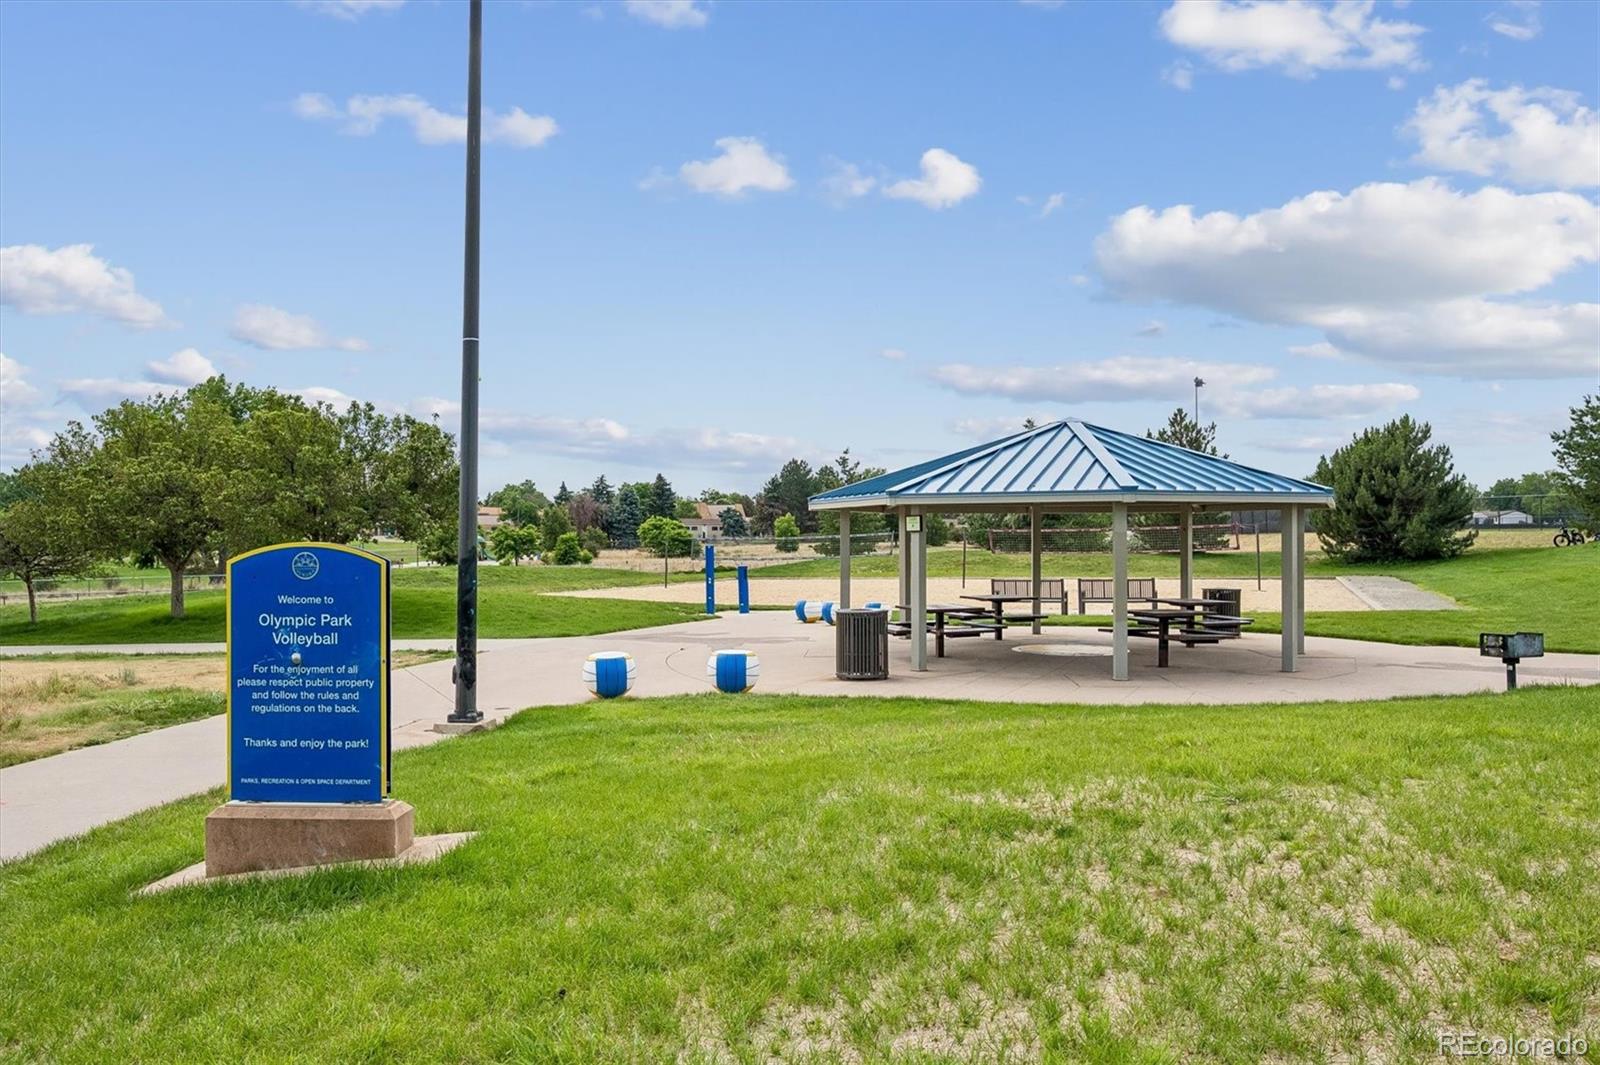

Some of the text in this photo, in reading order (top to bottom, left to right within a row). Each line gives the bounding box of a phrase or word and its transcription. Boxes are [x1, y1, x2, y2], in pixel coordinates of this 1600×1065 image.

[278, 594, 334, 604] Welcome to
[258, 614, 352, 630] Olympic Park
[272, 632, 338, 648] Volleyball
[253, 664, 358, 676] For the enjoyment of all
[237, 678, 374, 688] please respect public property
[252, 691, 360, 700] and follow the rules and
[251, 704, 301, 714] regulations
[318, 704, 332, 712] the
[334, 704, 360, 712] back.
[244, 738, 368, 750] Thanks and enjoy the park!
